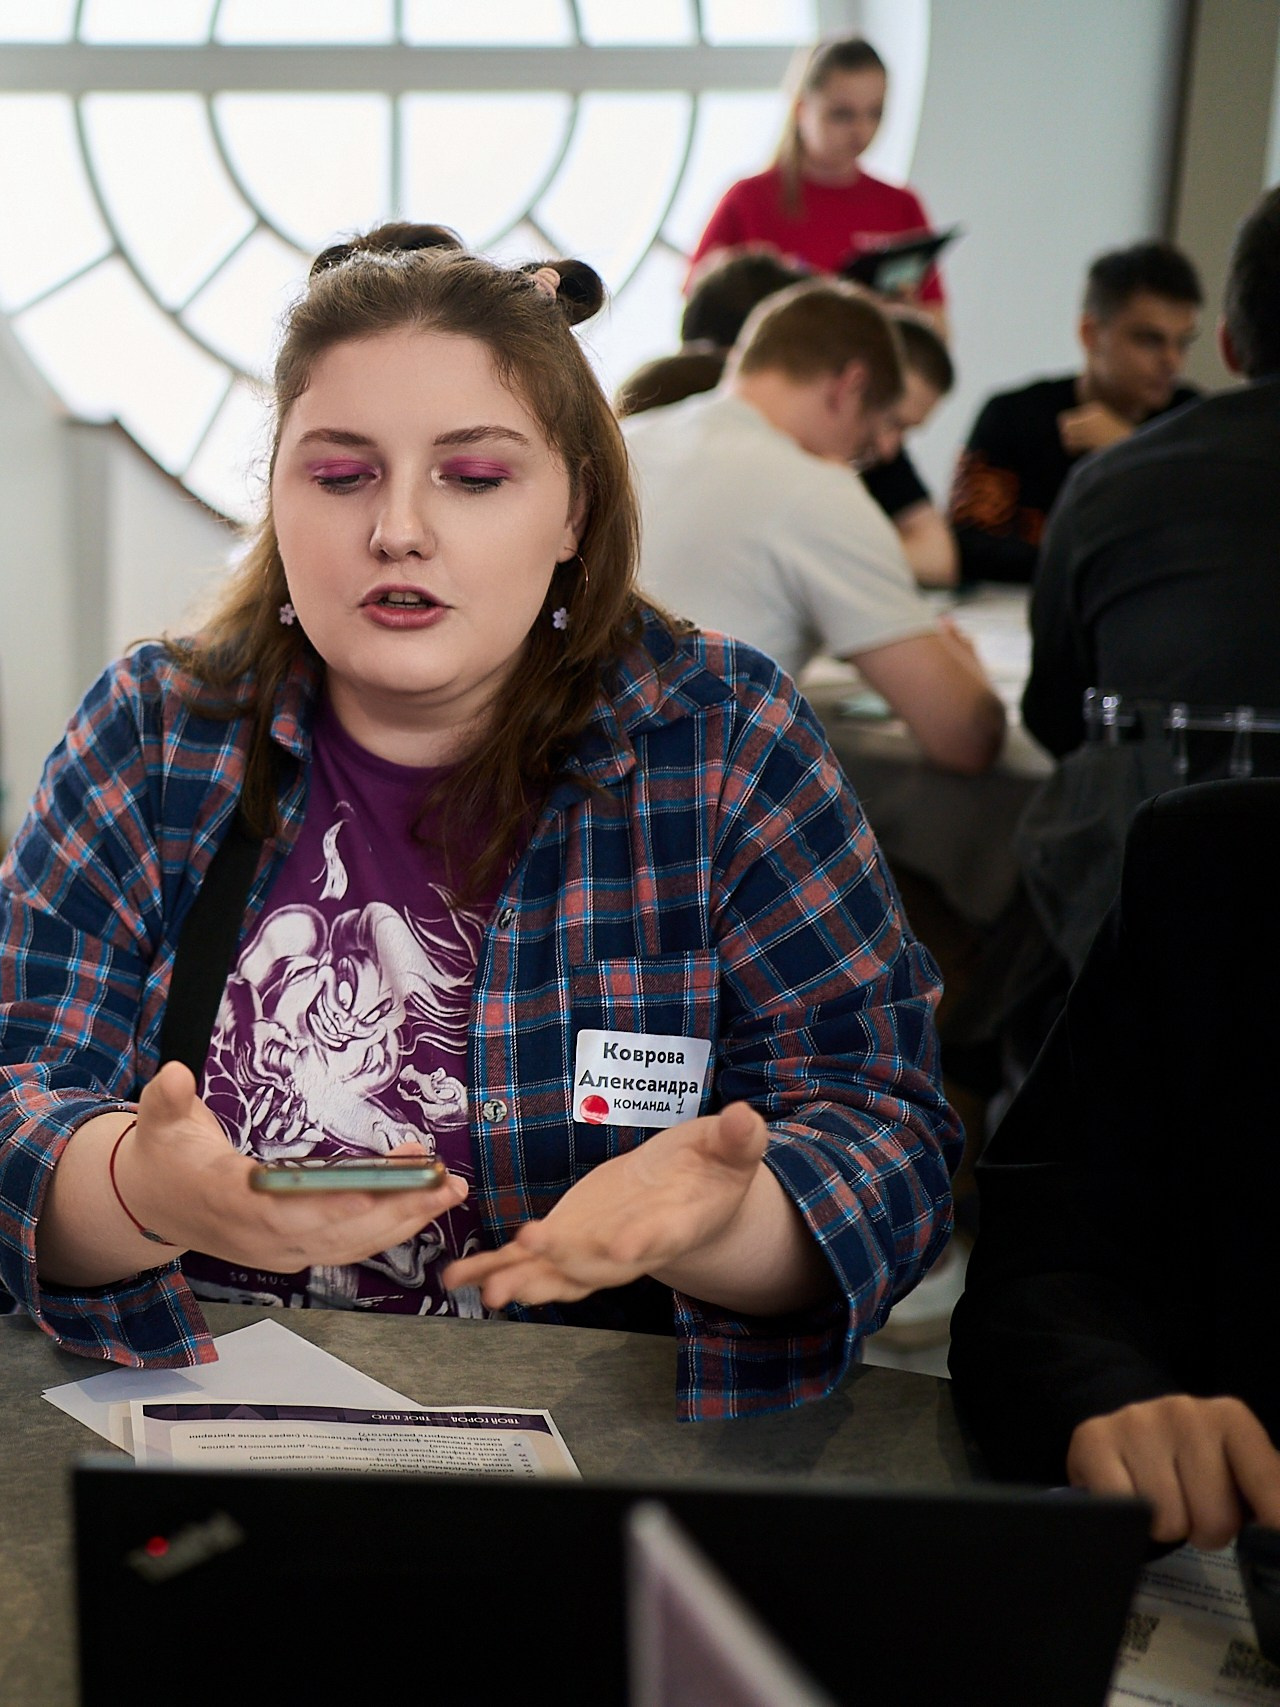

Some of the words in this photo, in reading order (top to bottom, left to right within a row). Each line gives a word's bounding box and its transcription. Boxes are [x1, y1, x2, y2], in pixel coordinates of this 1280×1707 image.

[602, 1042, 685, 1068] Коврова
[578, 1069, 699, 1098] Александра
[613, 1098, 671, 1112] КОМАНДА
[371, 1413, 401, 1421] ДЕЛО
[451, 1416, 489, 1424] ГОРОД
[491, 1417, 520, 1425] ТВОЙ
